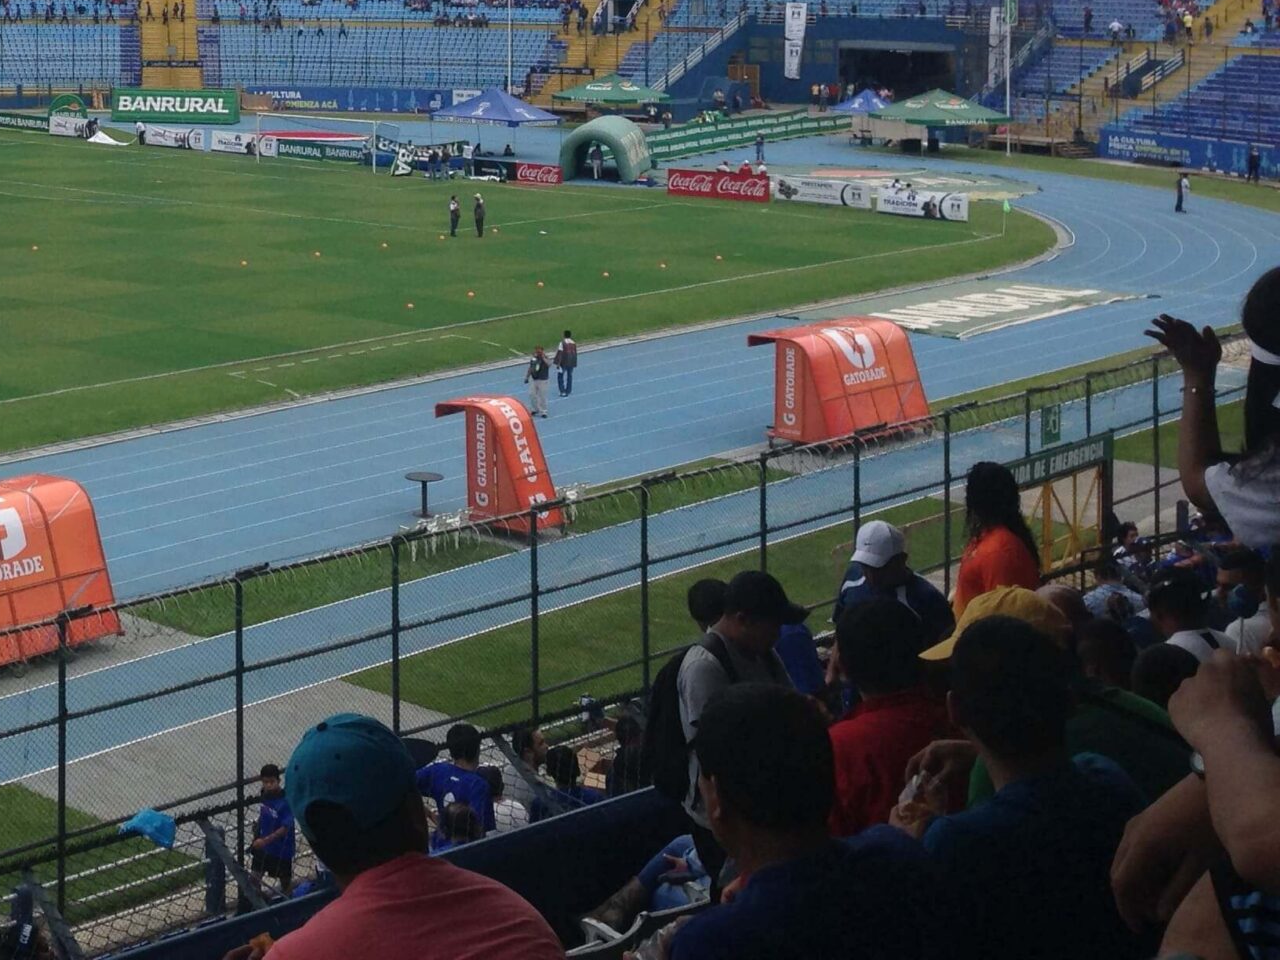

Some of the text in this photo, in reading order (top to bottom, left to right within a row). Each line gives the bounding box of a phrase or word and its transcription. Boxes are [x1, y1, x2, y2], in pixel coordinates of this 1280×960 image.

[118, 95, 230, 113] BANRURAL
[1120, 136, 1157, 146] CULTURA
[279, 143, 322, 158] BANRURAL
[325, 146, 365, 160] BANRURA
[868, 284, 1102, 329] ANRURAL
[784, 347, 796, 426] G GATORADE
[843, 367, 887, 386] GATORADE
[476, 414, 489, 507] G GATORADE
[1033, 458, 1047, 480] DE
